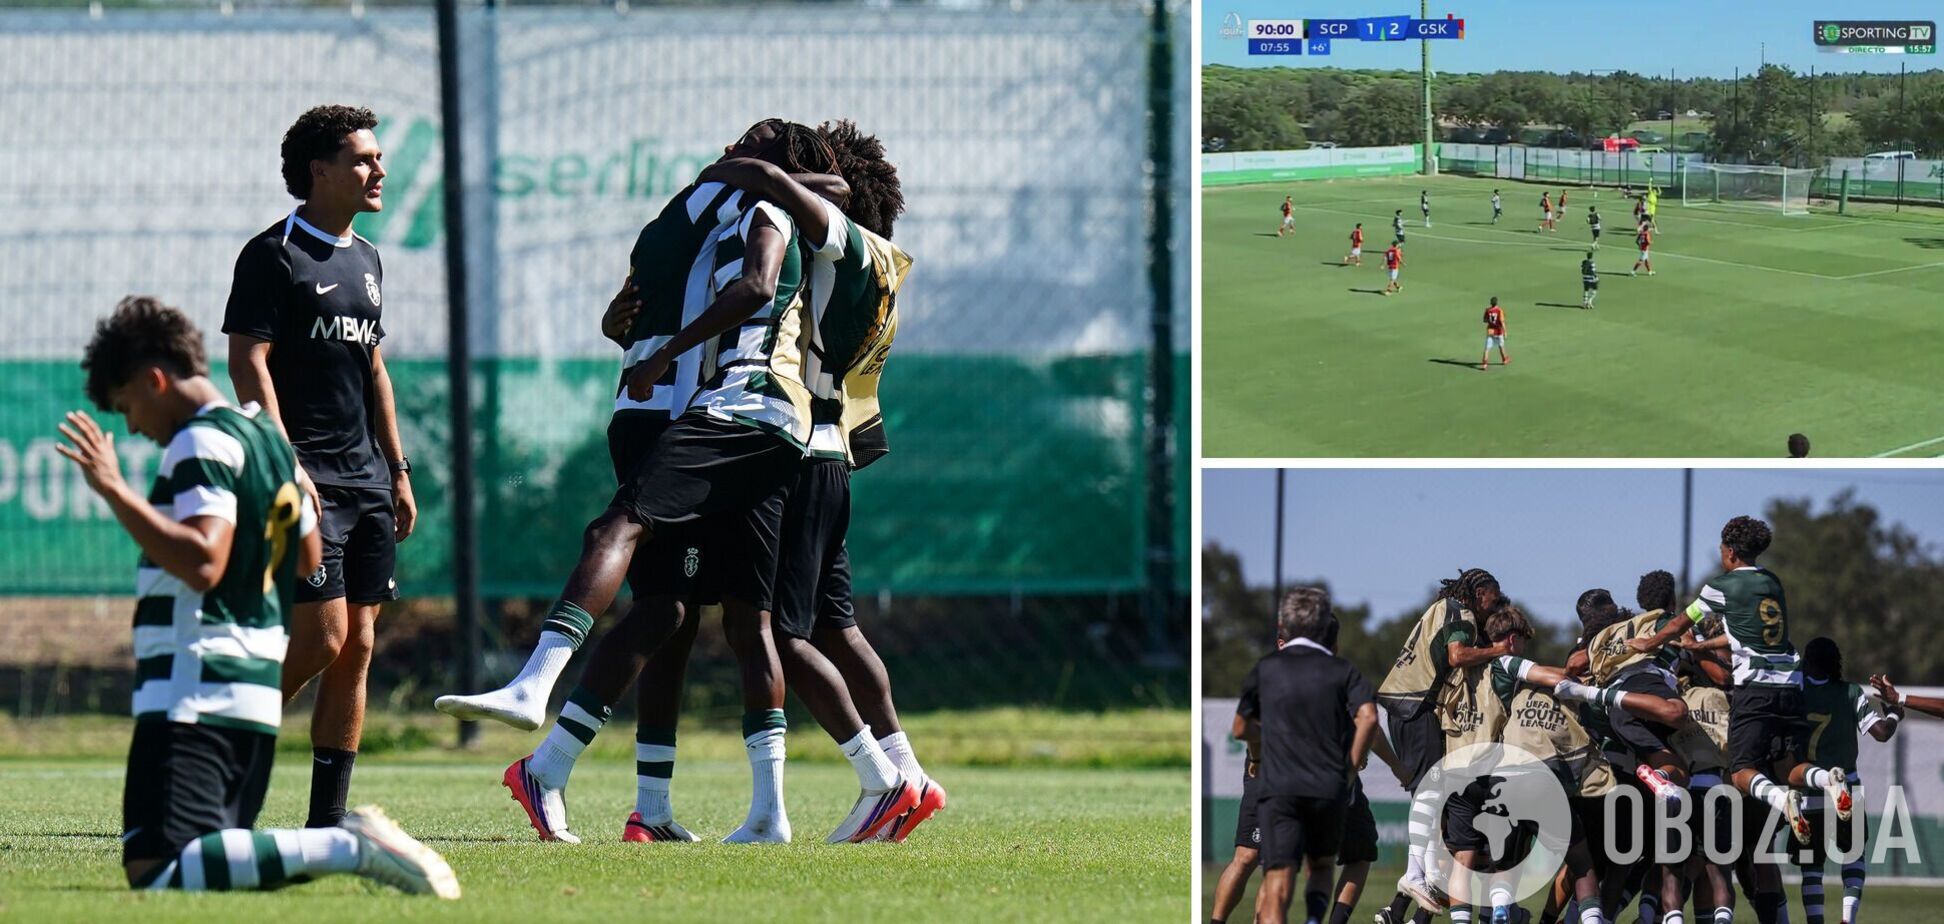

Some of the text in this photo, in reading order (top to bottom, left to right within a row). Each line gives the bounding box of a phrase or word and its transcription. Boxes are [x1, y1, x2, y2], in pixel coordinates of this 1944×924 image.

[1759, 598, 1784, 645] 9
[1526, 700, 1549, 709] UEFA
[1516, 708, 1567, 726] YOUTH
[1520, 719, 1558, 732] LEAGUE
[1806, 713, 1832, 761] 7
